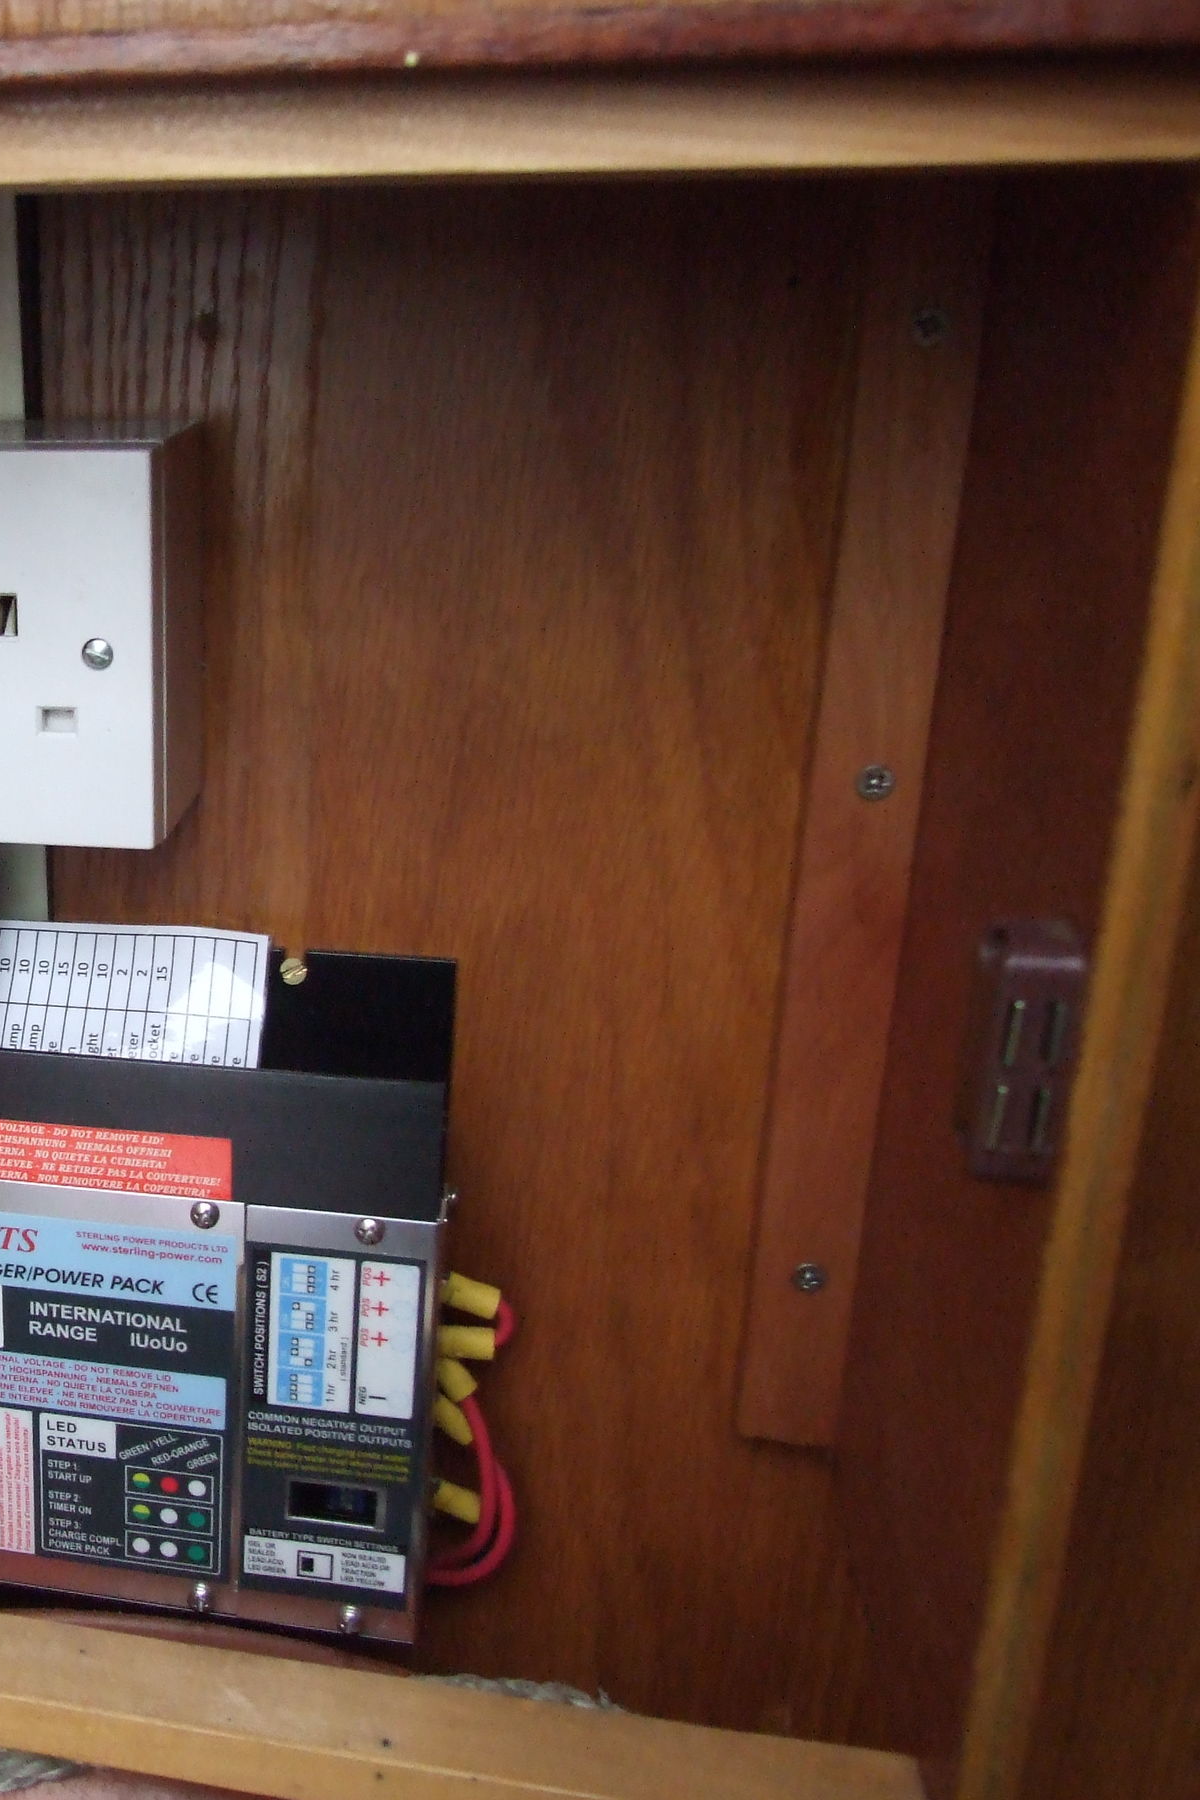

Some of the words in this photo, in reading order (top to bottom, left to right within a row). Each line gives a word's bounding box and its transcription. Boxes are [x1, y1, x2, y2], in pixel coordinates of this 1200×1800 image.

[0, 957, 11, 973] 10
[19, 958, 30, 974] 10
[39, 959, 49, 975] 10
[58, 961, 69, 976] 15
[78, 962, 89, 977] 10
[97, 963, 108, 979] 10
[117, 968, 128, 977] 2
[157, 965, 168, 981] 15
[137, 969, 148, 978] 2
[0, 1122, 44, 1135] VOLTAGE
[53, 1126, 68, 1136] DO
[70, 1128, 92, 1138] NOT
[95, 1130, 139, 1143] REMOVE
[141, 1134, 164, 1145] LID!
[34, 1149, 49, 1159] NO
[93, 1154, 106, 1164] LA
[75, 1230, 120, 1242] STERLING
[122, 1235, 156, 1246] POWER
[158, 1239, 209, 1251] PRODUCTS
[211, 1245, 228, 1253] LTD
[81, 1241, 222, 1266] www.sterling-power.com
[362, 1266, 371, 1286] POS
[110, 1274, 164, 1295] PACK
[361, 1297, 370, 1317] POS
[29, 1300, 187, 1333] INTERNATIONAL
[254, 1290, 266, 1350] POSITIONS
[28, 1320, 97, 1342] RANGE
[129, 1332, 187, 1353] IUoUo
[360, 1327, 368, 1347] POS
[253, 1352, 264, 1395] SWITCH
[358, 1385, 366, 1405] NEG
[46, 1419, 77, 1434] LED
[247, 1410, 299, 1424] COMMON
[301, 1416, 356, 1431] NEGATIVE
[359, 1423, 406, 1437] OUTPUT
[247, 1421, 303, 1436] ISOLATED
[304, 1428, 355, 1442] POSITIVE
[46, 1435, 106, 1453] STATUS
[47, 1459, 70, 1470] STEP
[47, 1470, 77, 1482] START
[79, 1474, 92, 1484] UP
[48, 1490, 71, 1501] STEP
[48, 1501, 75, 1512] TIMER
[78, 1505, 91, 1515] ON
[48, 1517, 71, 1528] STEP
[48, 1528, 86, 1541] CHARGE
[48, 1539, 81, 1551] POWER
[84, 1544, 110, 1555] PACK
